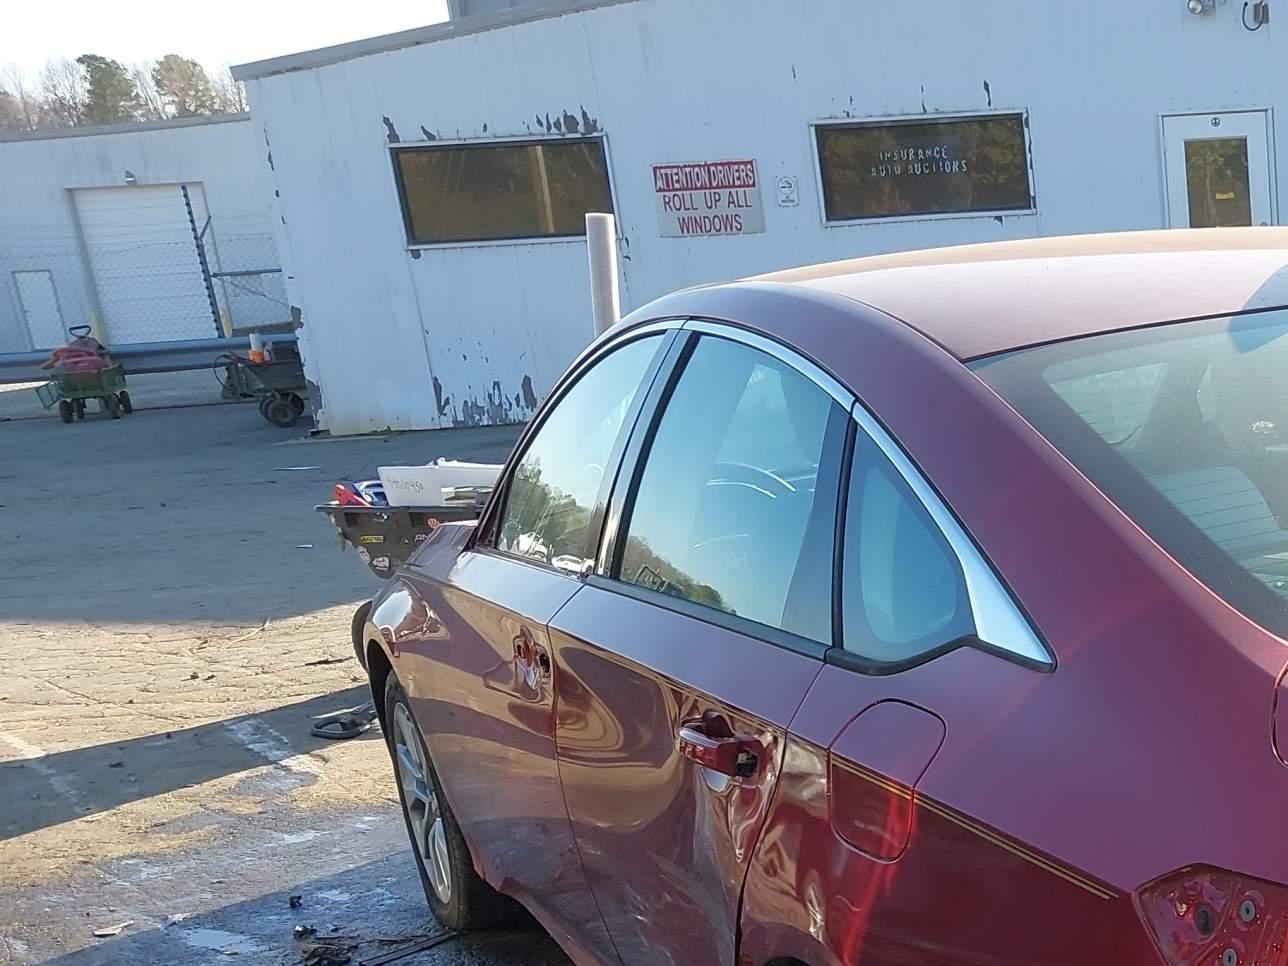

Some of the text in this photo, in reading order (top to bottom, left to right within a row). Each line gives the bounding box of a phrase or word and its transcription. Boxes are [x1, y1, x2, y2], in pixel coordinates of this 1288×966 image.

[880, 146, 948, 161] INSURANCE
[656, 164, 754, 190] ATTENTION DRIVERS
[662, 189, 753, 212] ROLL UP ALL
[677, 213, 743, 235] WINDOWS
